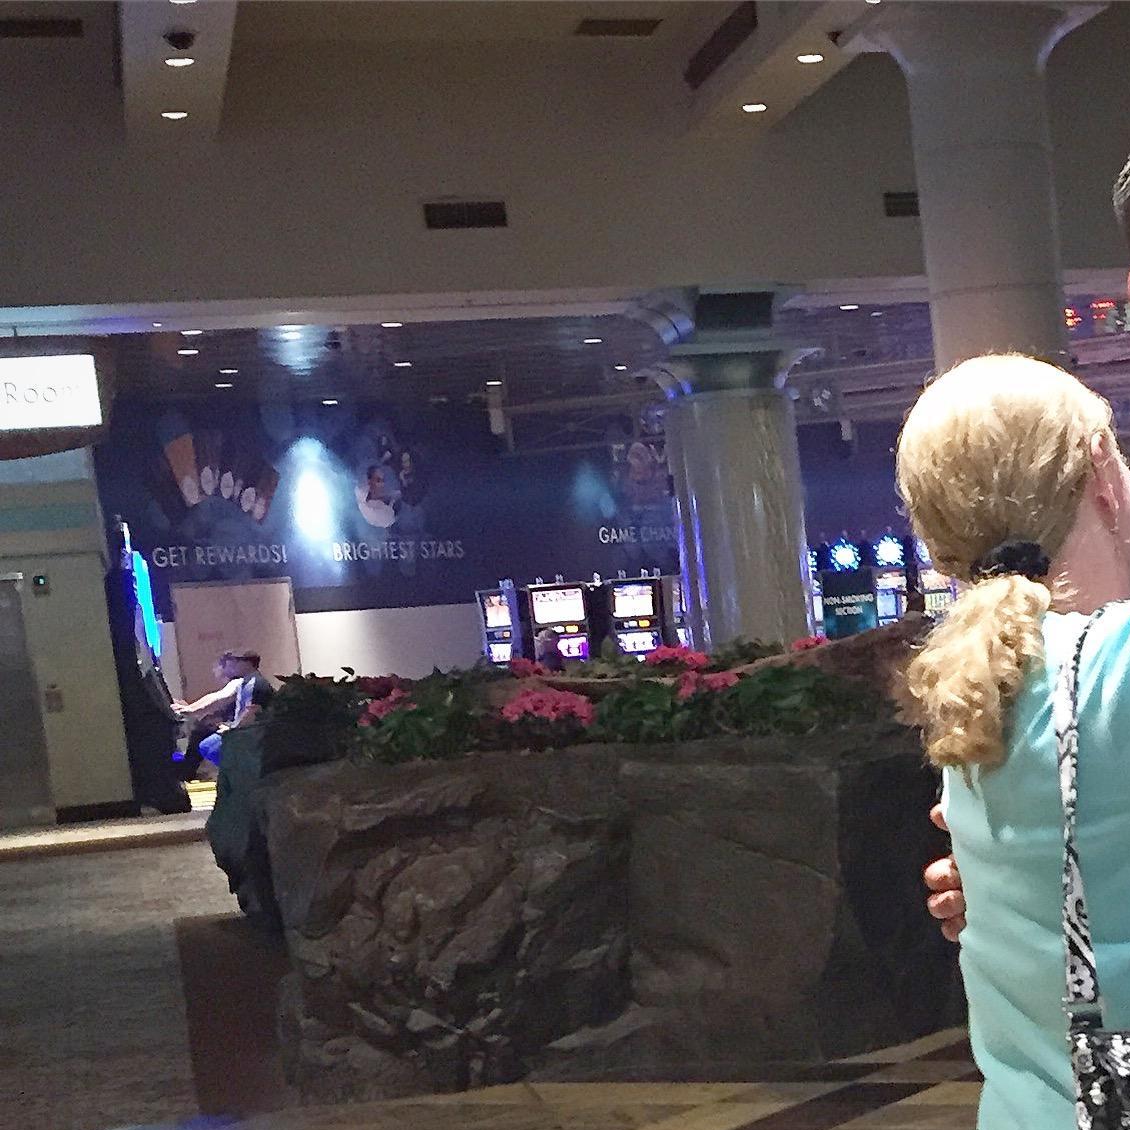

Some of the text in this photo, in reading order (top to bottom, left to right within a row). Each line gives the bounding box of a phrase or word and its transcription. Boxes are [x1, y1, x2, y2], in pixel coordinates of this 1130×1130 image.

[4, 382, 80, 404] Roo
[598, 526, 679, 544] GAME CHAN
[152, 543, 288, 568] GET REWARDS!
[332, 539, 465, 562] BRIGHTEST STARS
